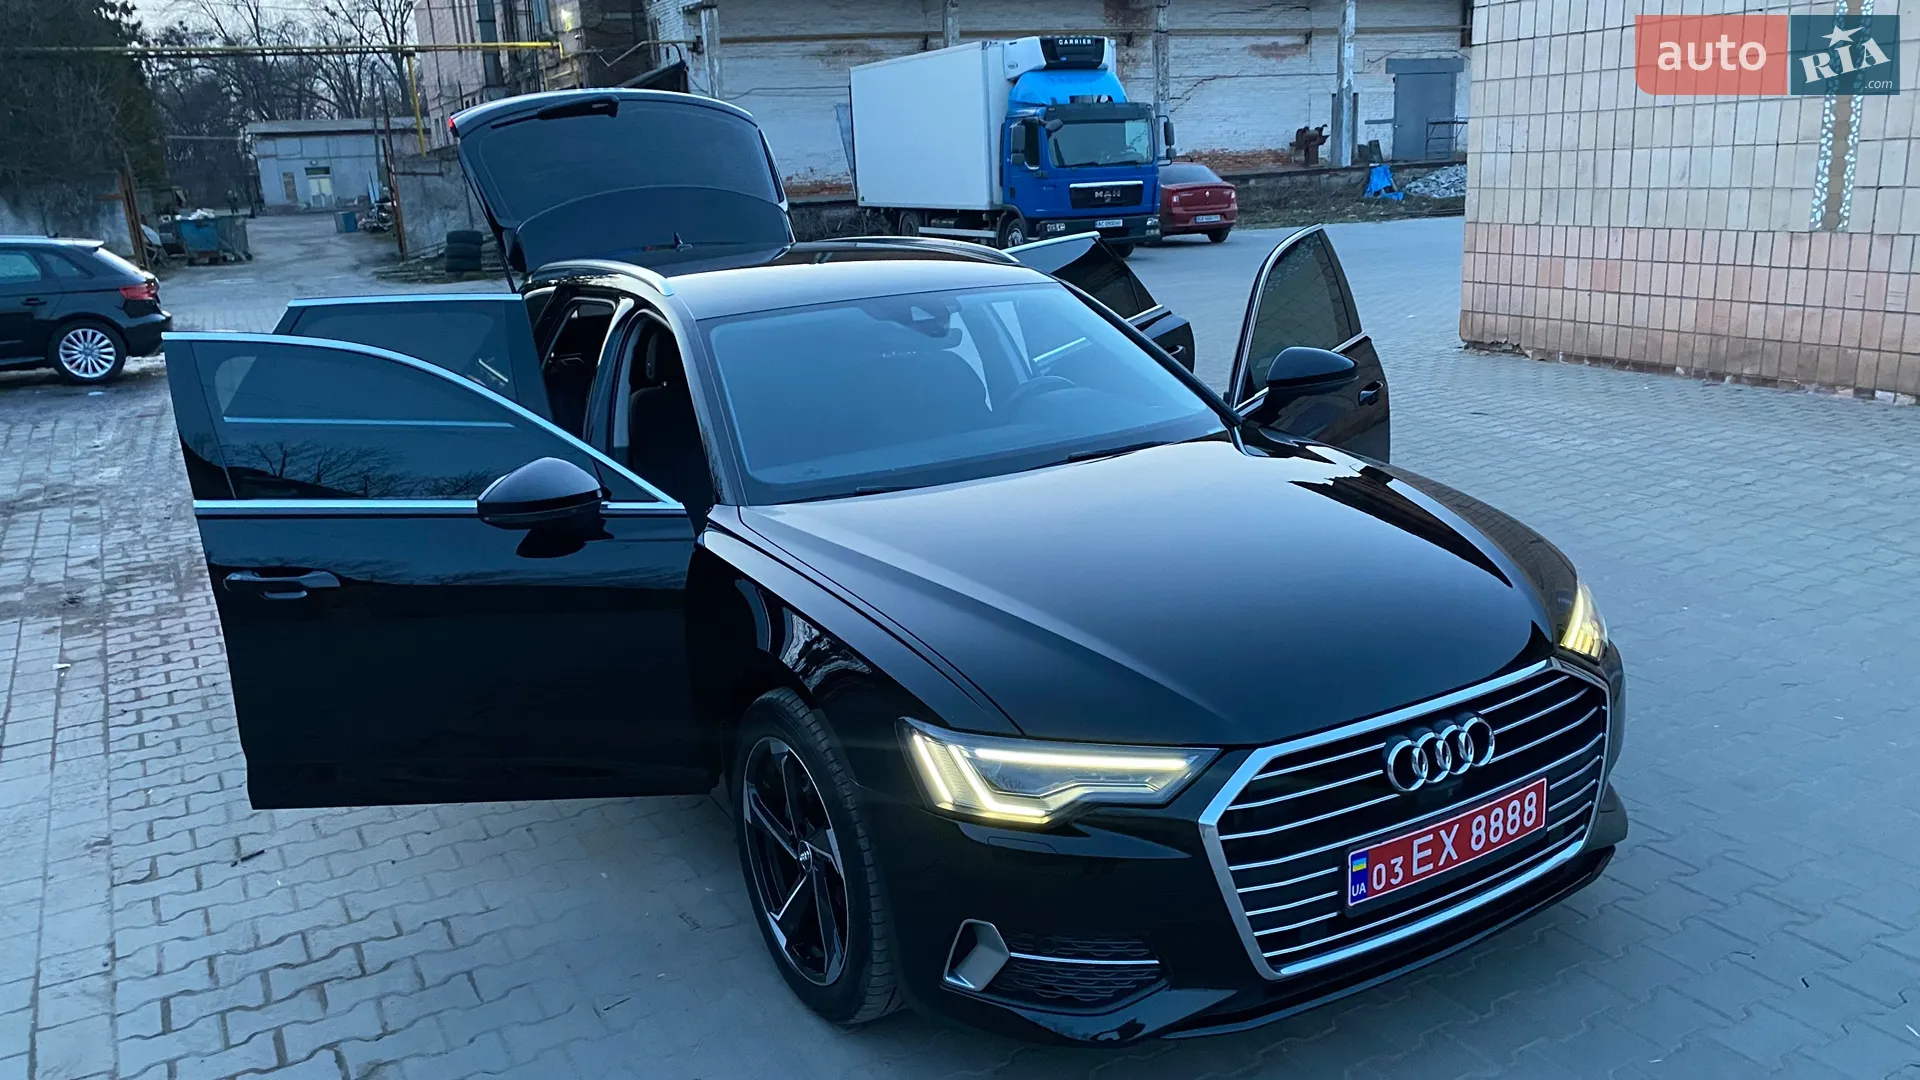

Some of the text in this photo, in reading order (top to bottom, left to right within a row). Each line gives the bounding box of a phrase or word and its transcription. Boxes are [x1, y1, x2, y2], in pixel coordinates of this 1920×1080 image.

[1094, 190, 1121, 198] MAN
[1372, 791, 1537, 891] 03 EX 8888
[1351, 882, 1367, 897] UA
